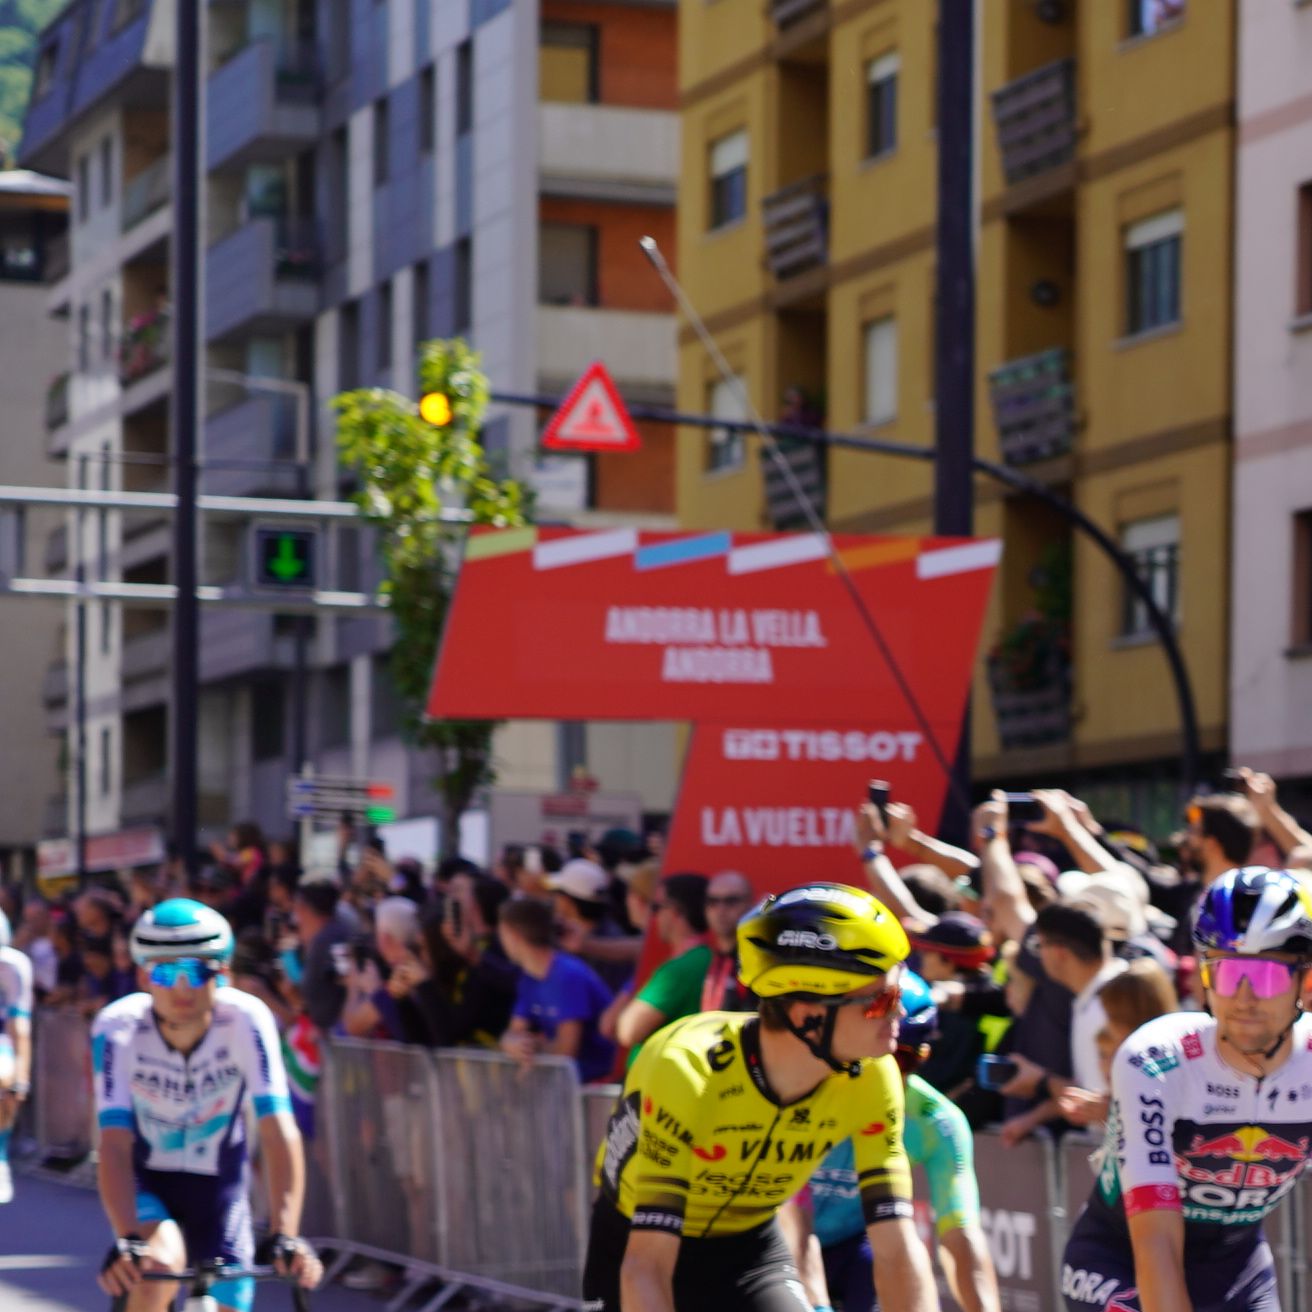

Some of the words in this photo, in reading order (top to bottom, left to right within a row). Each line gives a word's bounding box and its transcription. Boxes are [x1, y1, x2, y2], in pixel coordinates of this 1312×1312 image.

[605, 606, 713, 644] ANDORRA
[719, 609, 750, 646] LA
[661, 647, 774, 684] ANDORRA
[781, 731, 923, 762] TISSOT
[702, 808, 741, 846] LA
[744, 807, 855, 846] VUELTA
[1139, 1094, 1171, 1166] BOSS
